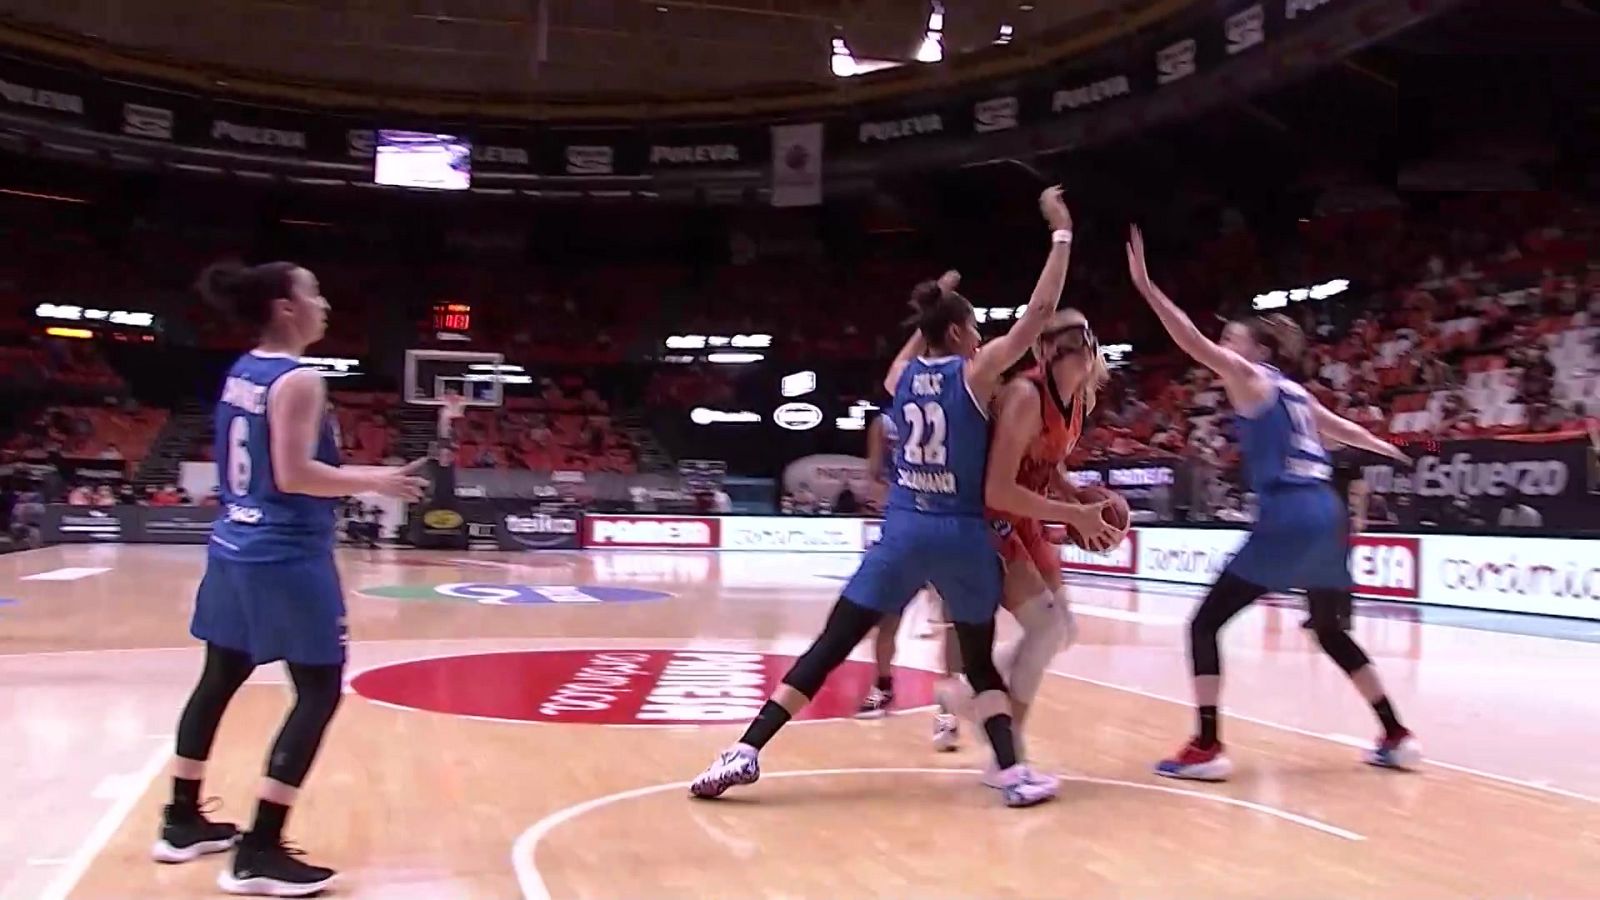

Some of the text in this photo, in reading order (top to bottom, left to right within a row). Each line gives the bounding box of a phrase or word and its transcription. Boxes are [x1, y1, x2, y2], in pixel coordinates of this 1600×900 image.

[473, 145, 528, 165] LEVA
[228, 415, 252, 497] 6
[903, 402, 946, 466] 22
[1416, 453, 1567, 497] Esfuerzo
[1352, 545, 1414, 589] ESA
